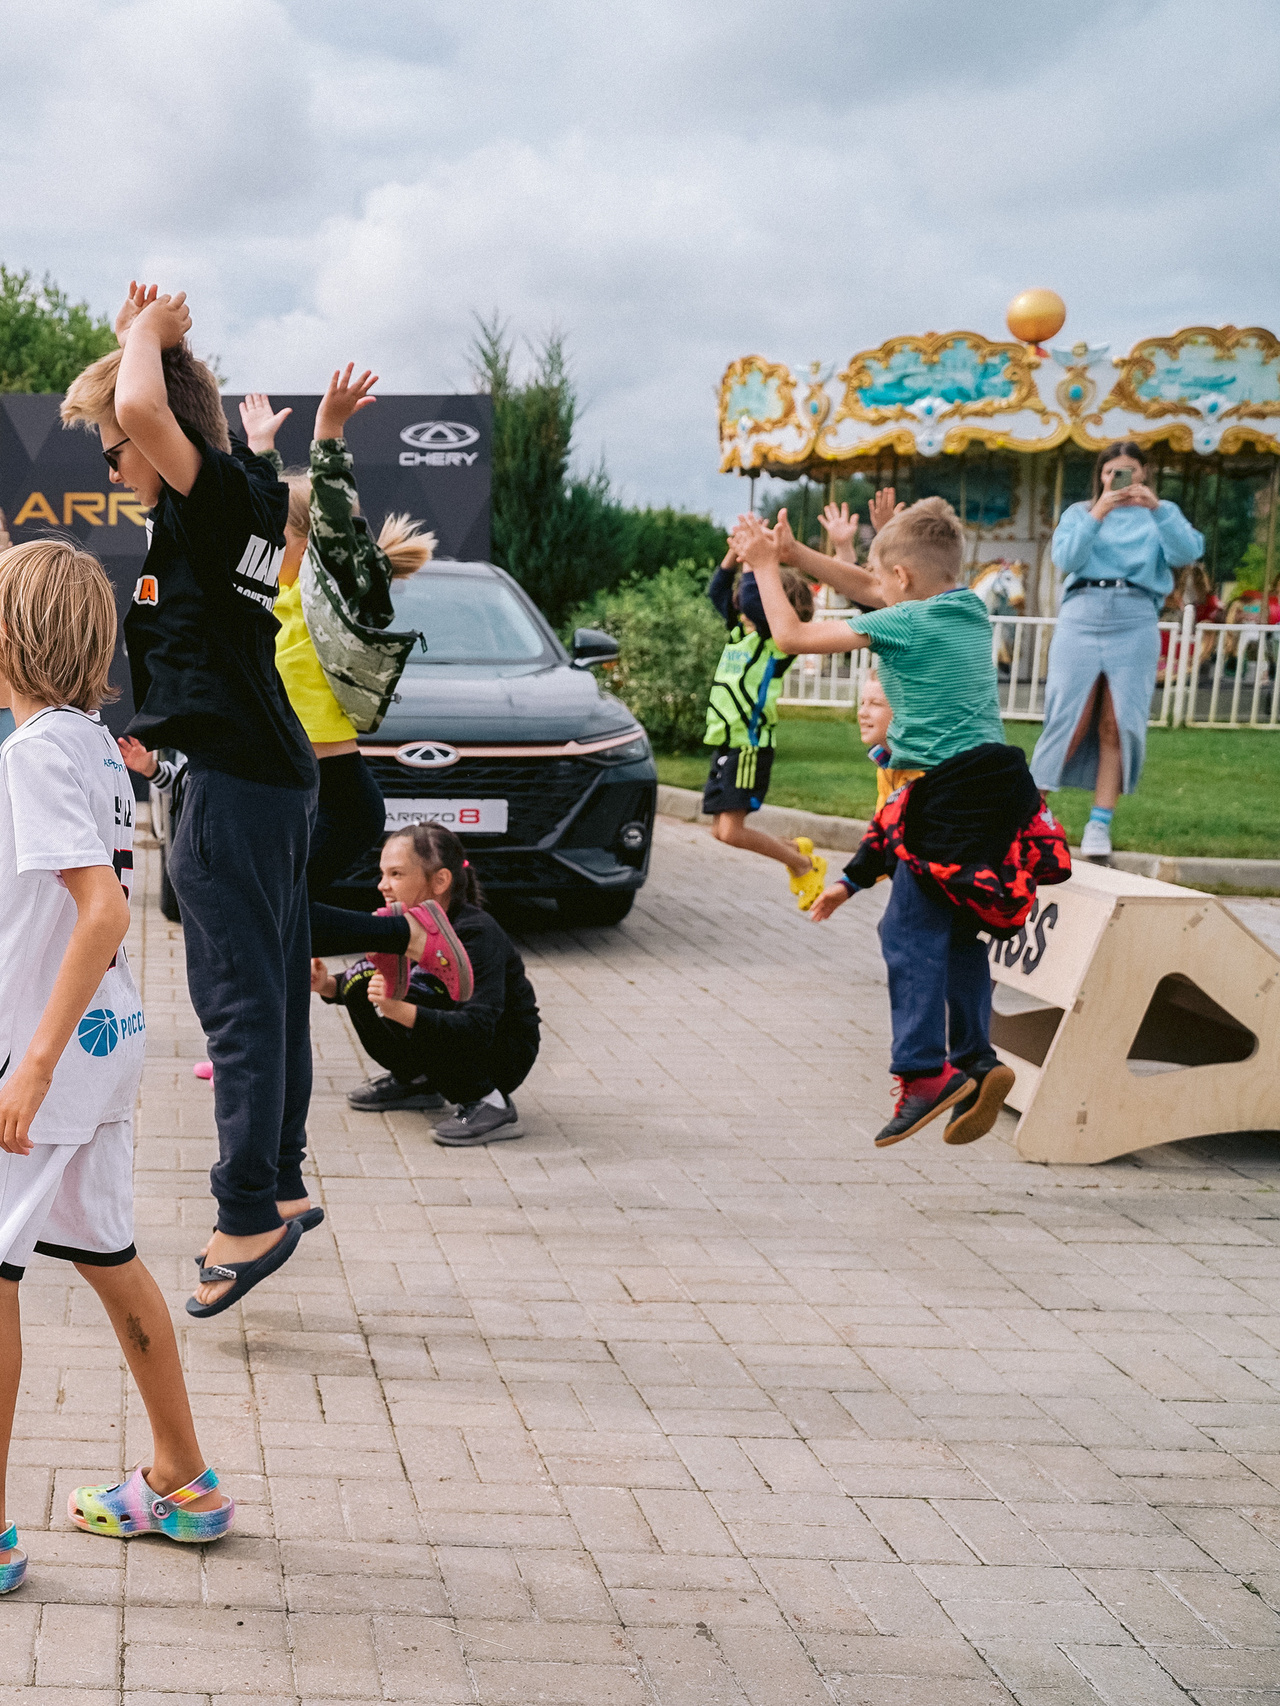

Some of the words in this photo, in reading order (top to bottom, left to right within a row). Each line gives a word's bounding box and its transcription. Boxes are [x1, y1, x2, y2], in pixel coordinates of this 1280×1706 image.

[398, 451, 480, 467] CHERY
[13, 491, 150, 526] ARR
[385, 812, 456, 823] ARRIZO
[458, 808, 480, 824] 8
